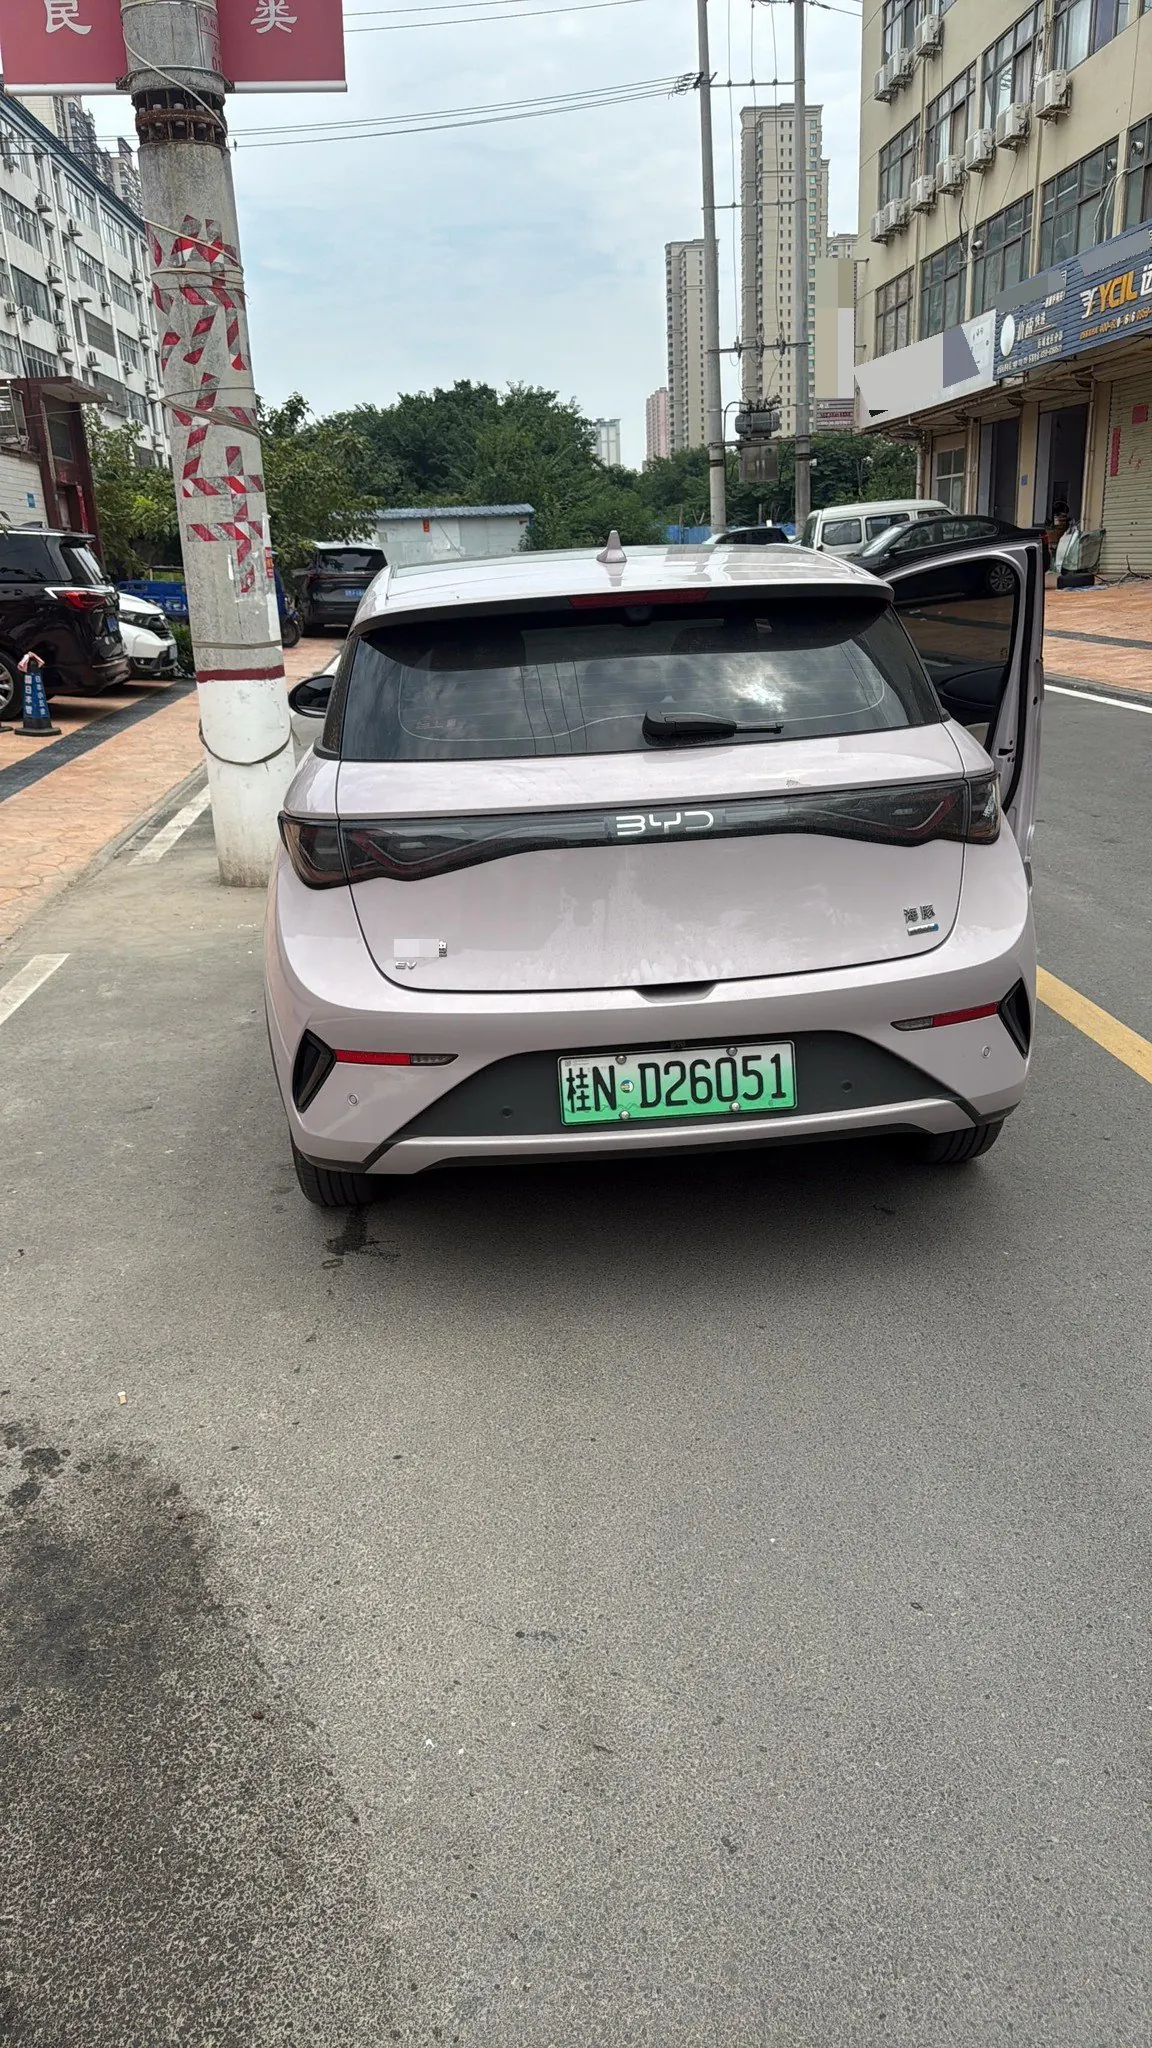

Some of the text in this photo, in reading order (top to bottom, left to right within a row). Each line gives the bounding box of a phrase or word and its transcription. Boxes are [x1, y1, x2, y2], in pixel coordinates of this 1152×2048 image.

[250, 0, 298, 34] 类
[616, 811, 714, 836] BYD
[395, 961, 417, 970] EV
